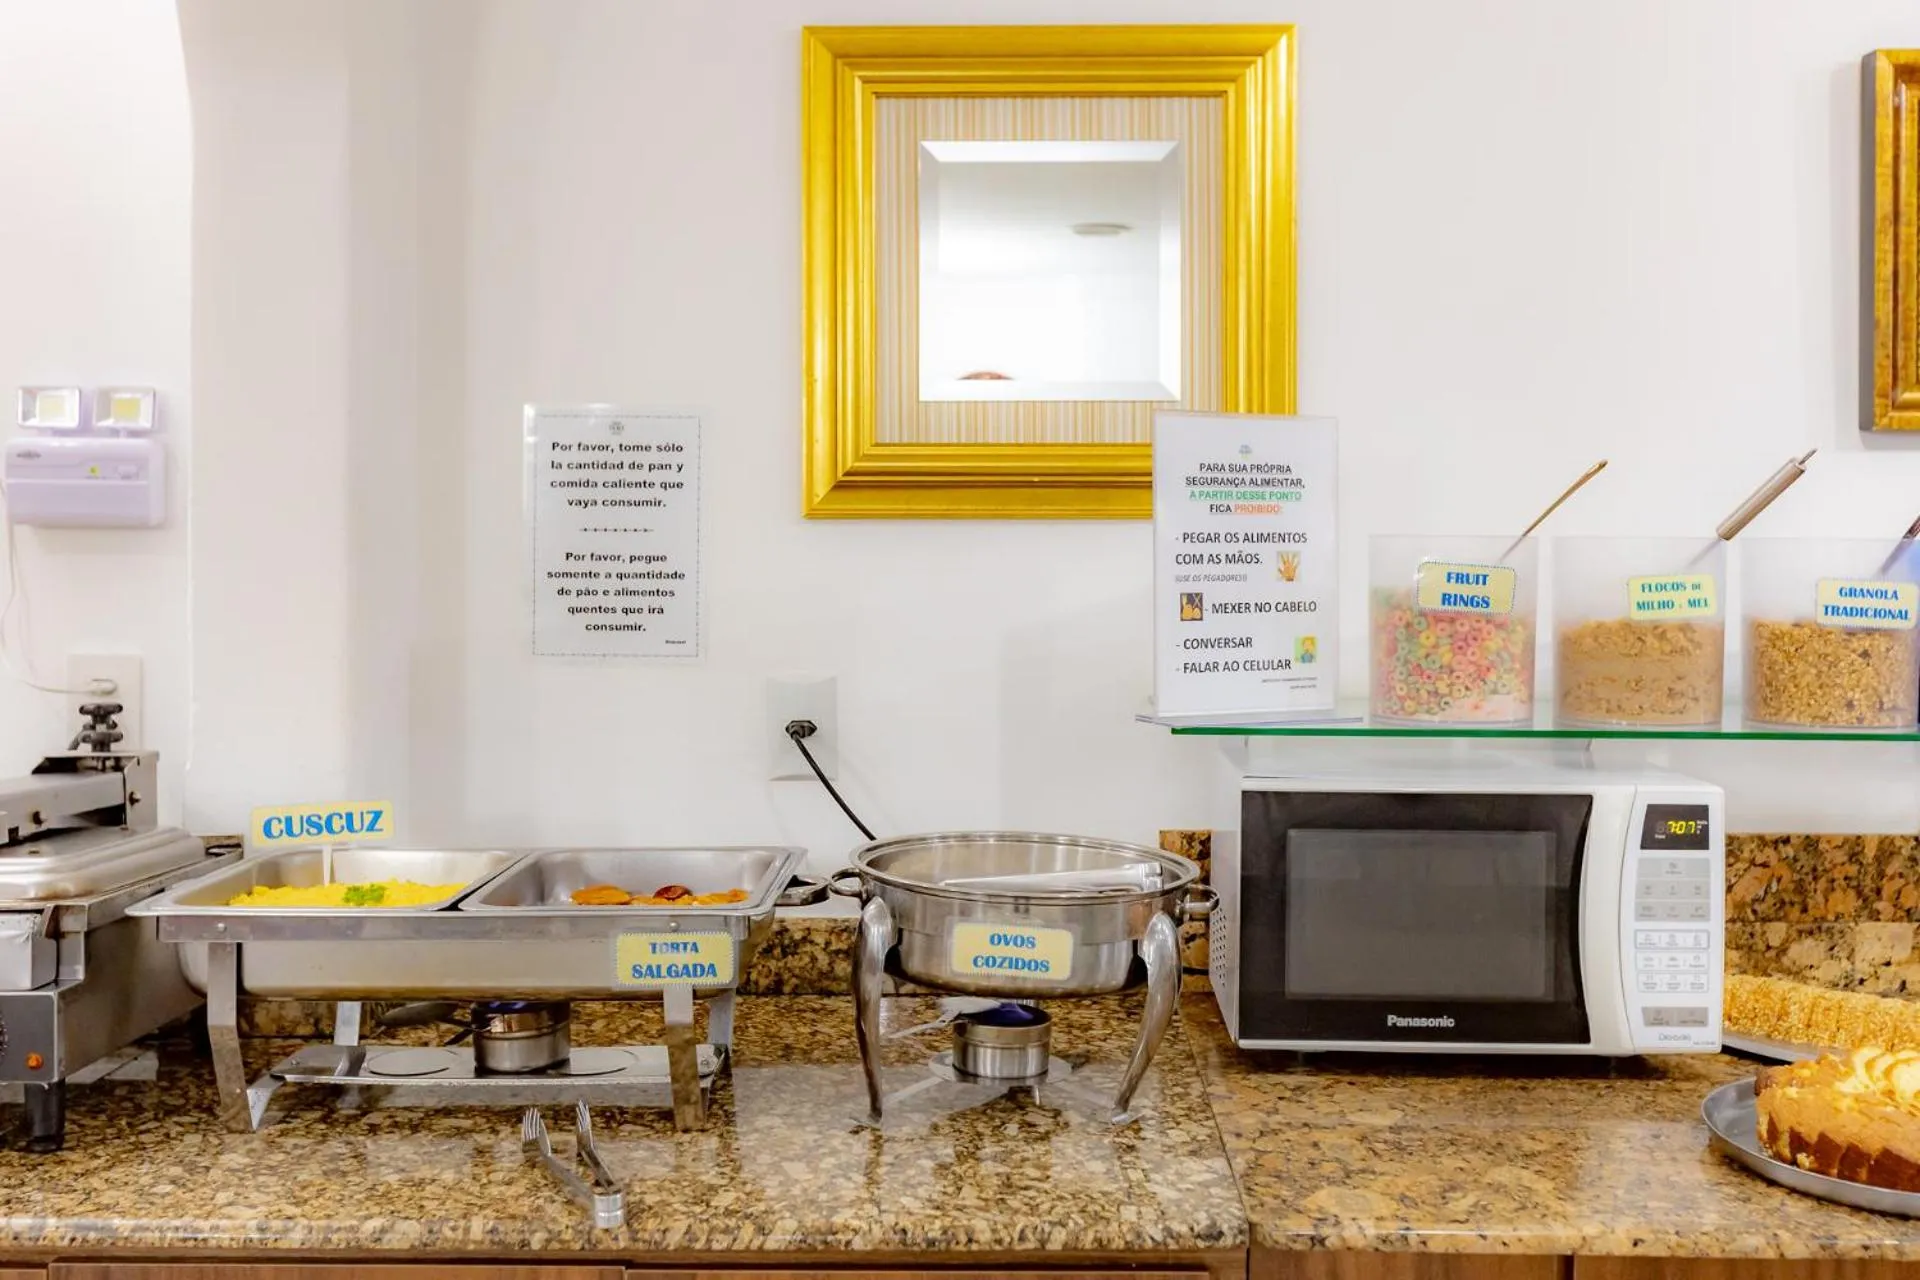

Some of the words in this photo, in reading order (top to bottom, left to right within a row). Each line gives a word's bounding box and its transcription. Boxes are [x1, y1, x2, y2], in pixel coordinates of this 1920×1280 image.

[552, 442, 573, 451] Por
[577, 442, 614, 453] favor,
[619, 443, 652, 452] tome
[656, 442, 683, 452] sólo
[551, 460, 563, 470] la
[567, 460, 624, 470] cantidad
[628, 460, 644, 470] de
[648, 463, 672, 472] pan
[676, 463, 683, 472] y
[1200, 463, 1226, 472] PARA
[1228, 464, 1248, 472] SUA
[1250, 463, 1292, 473] PRÓPRIA
[550, 478, 598, 488] comida
[602, 479, 655, 489] caliente
[660, 481, 684, 490] que
[1185, 476, 1245, 487] SEGURANÇA
[1248, 478, 1305, 488] ALIMENTAR,
[1189, 491, 1197, 500] A
[1198, 491, 1234, 500] PARTIR
[1236, 491, 1267, 500] DESSE
[1269, 491, 1302, 500] PONTO
[567, 499, 598, 508] vaya
[602, 497, 666, 507] consumir.
[1209, 504, 1232, 513] FICA
[1182, 532, 1220, 543] PEGAR
[1224, 532, 1239, 543] OS
[1242, 532, 1308, 543] ALIMENTOS
[565, 552, 586, 561] Por
[590, 552, 625, 563] favor,
[629, 555, 667, 563] pegue
[1175, 553, 1204, 565] COM
[1207, 554, 1222, 564] AS
[1225, 550, 1263, 564] MÃOS.
[547, 571, 601, 579] somente
[616, 570, 685, 580] quantidade
[1446, 572, 1489, 586] FRUIT
[557, 587, 572, 596] de
[576, 587, 599, 597] pão
[614, 587, 675, 597] alimentos
[1641, 582, 1687, 593] FLOCOS
[1838, 586, 1899, 601] GRANOLA
[1441, 592, 1491, 608] RINGS
[1636, 599, 1675, 611] MILHO
[567, 605, 617, 615] quentes
[621, 607, 644, 615] que
[1211, 602, 1251, 614] MEXER
[1254, 602, 1272, 613] NO
[1275, 601, 1317, 613] CABELO
[1823, 604, 1910, 620] TRADICIONAL
[585, 622, 646, 632] consumir.
[1183, 637, 1252, 650] CONVERSAR
[1183, 661, 1219, 673] FALAR
[1222, 660, 1240, 672] AO
[1243, 659, 1291, 671] CELULAR
[262, 810, 384, 840] CUSCUZ
[989, 932, 1037, 949] OVOS
[648, 941, 700, 955] TORTA
[972, 954, 1051, 973] COZIDOS
[631, 962, 718, 979] SALGADA
[1386, 1014, 1455, 1028] Panasonic
